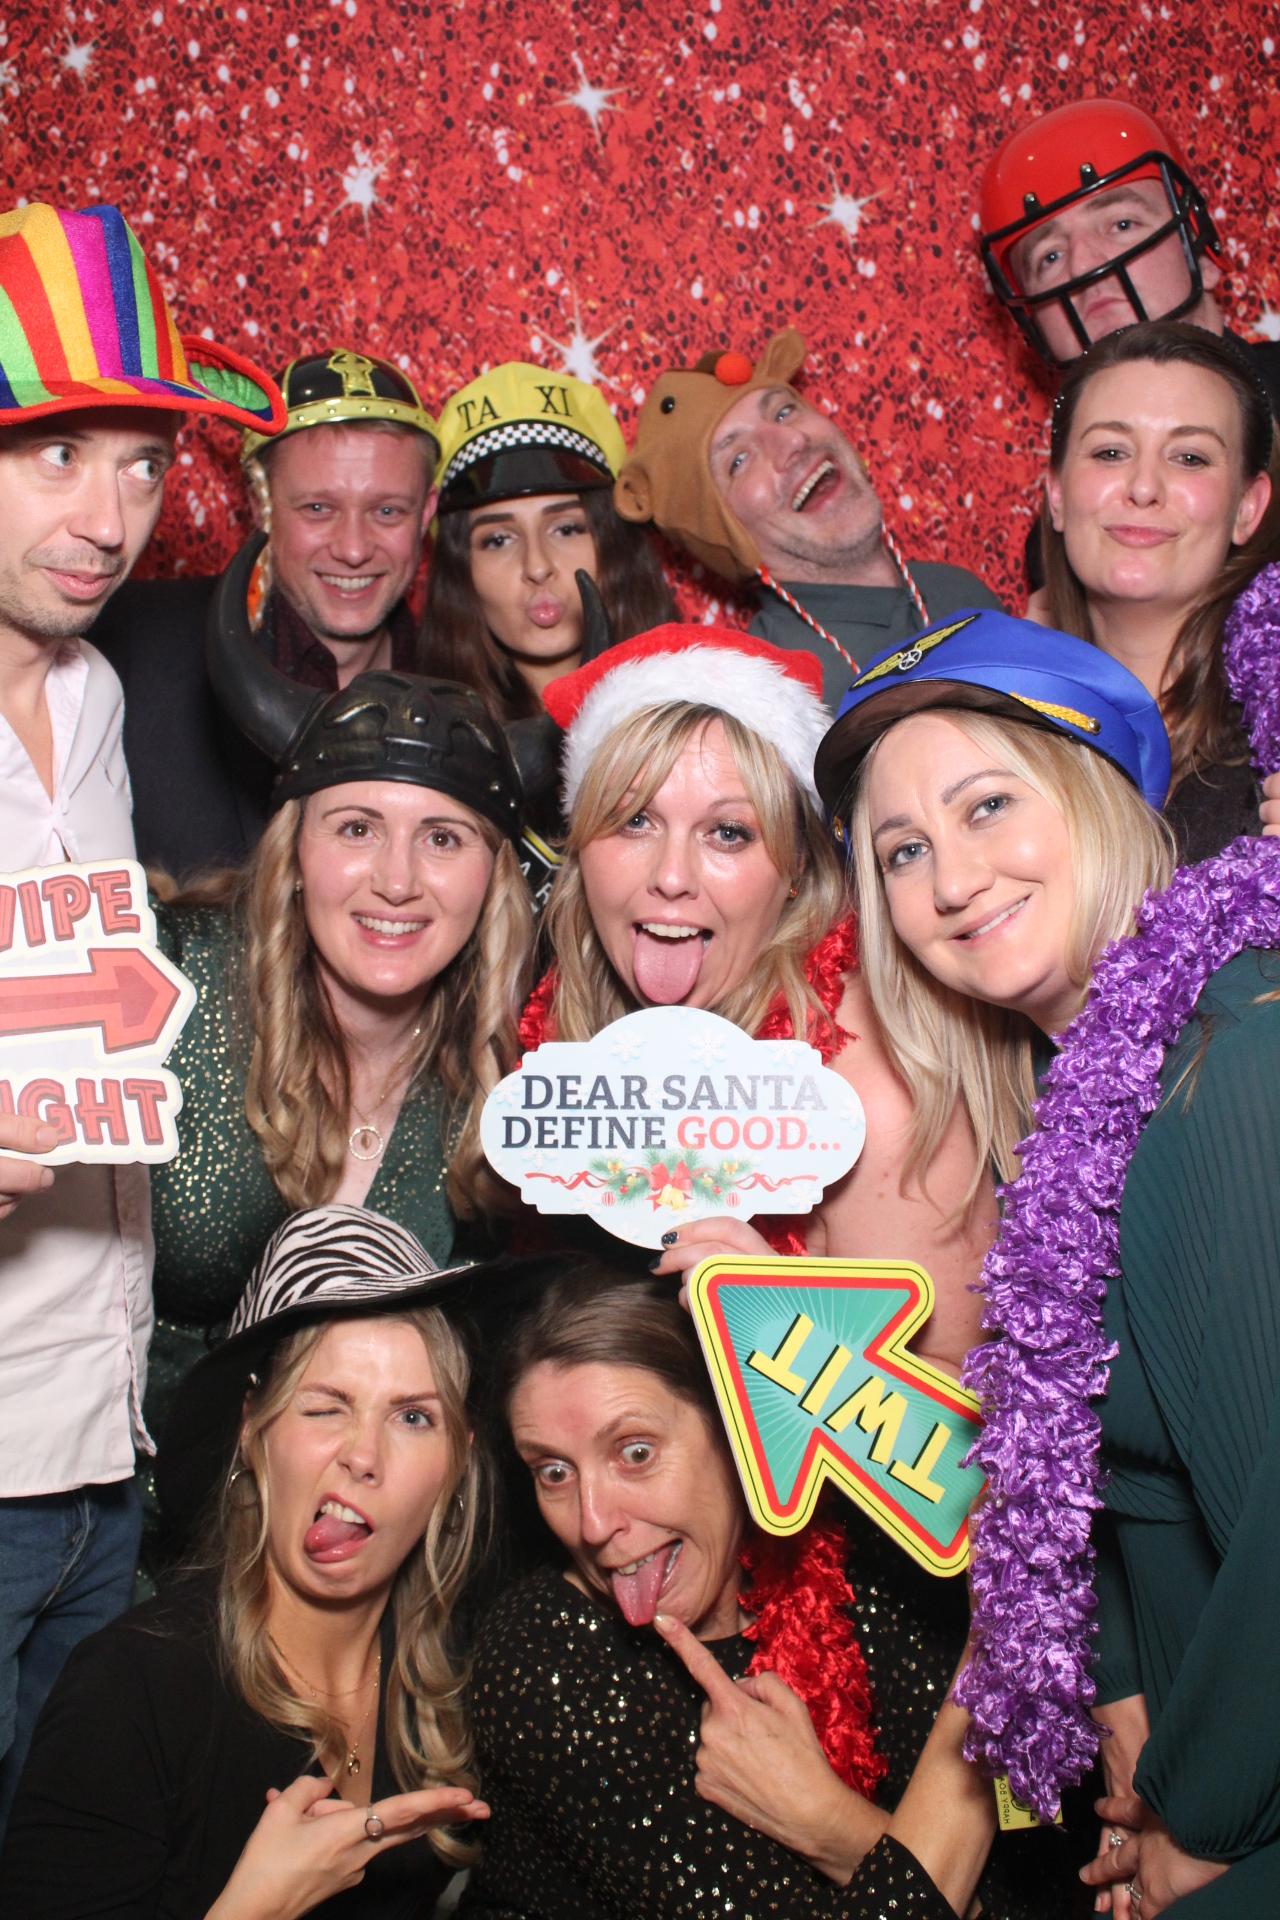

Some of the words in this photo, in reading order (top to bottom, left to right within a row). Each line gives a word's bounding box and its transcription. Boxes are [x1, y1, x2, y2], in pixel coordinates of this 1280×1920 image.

[0, 870, 140, 949] IPE
[521, 1075, 651, 1111] DEAR
[661, 1075, 826, 1111] SANTA
[501, 1116, 667, 1150] DEFINE
[677, 1116, 842, 1150] GOOD...
[745, 1312, 952, 1505] TWIT
